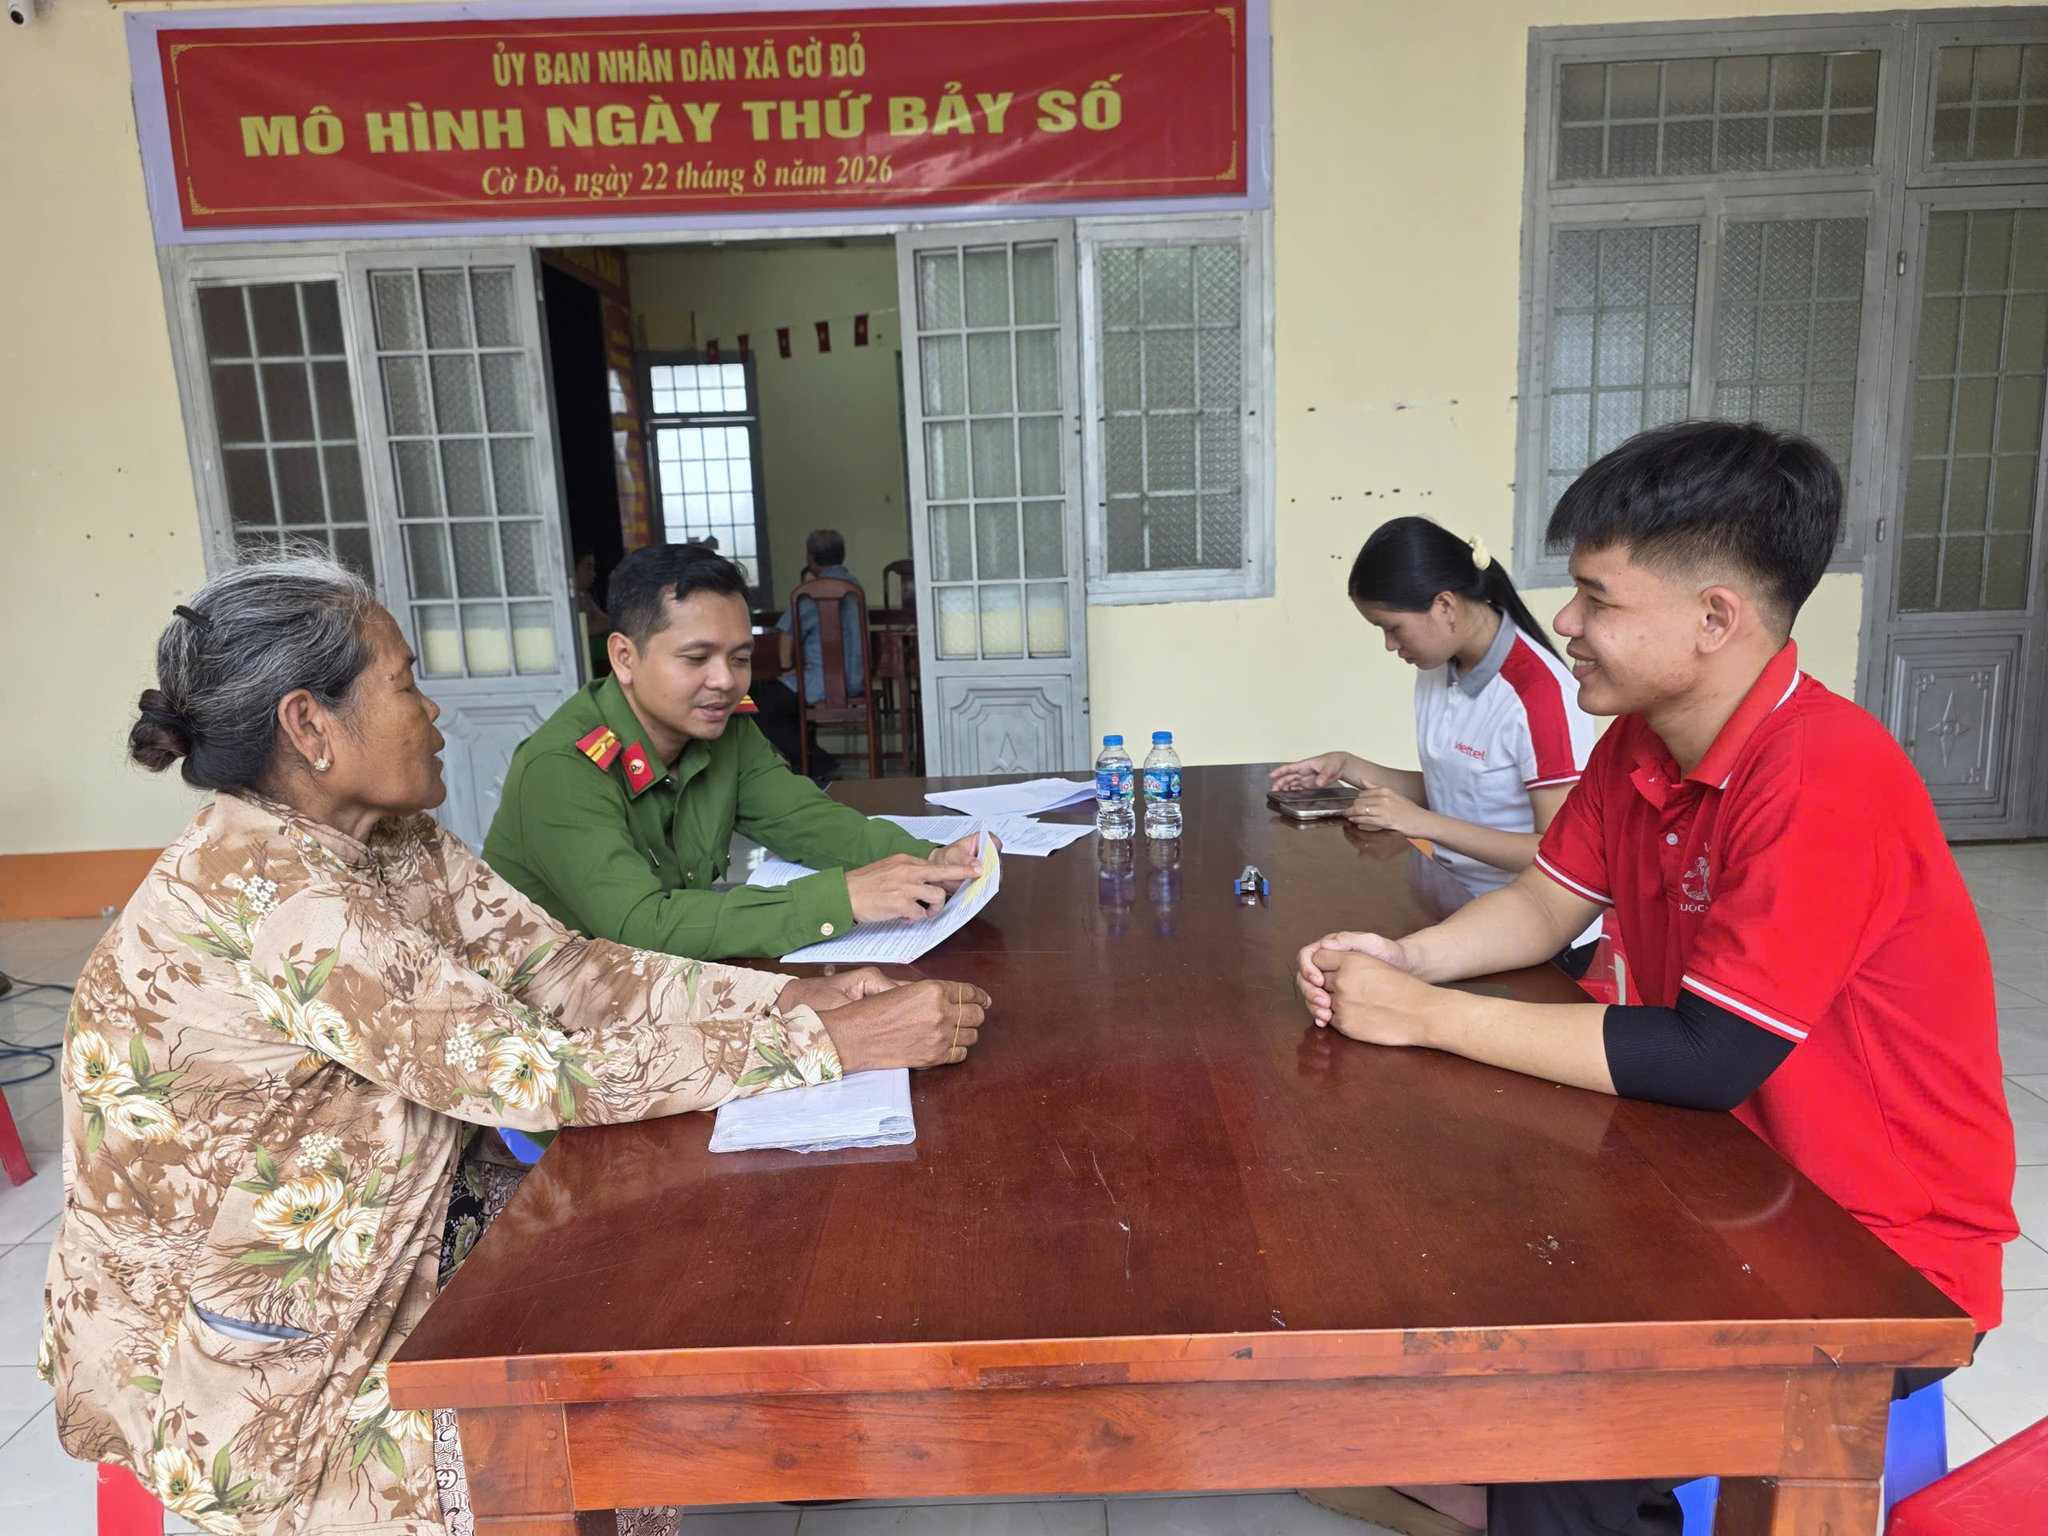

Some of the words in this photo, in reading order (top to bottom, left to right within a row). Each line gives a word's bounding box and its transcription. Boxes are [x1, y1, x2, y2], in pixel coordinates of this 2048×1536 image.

[493, 41, 525, 86] ỦY
[534, 51, 590, 85] BAN
[598, 42, 673, 83] NHÂN
[681, 40, 736, 82] DÂN
[743, 39, 780, 80] XÃ
[787, 36, 822, 78] CỜ
[830, 31, 865, 77] ĐỎ
[240, 105, 345, 157] MÔ
[365, 101, 525, 153] HÌNH
[546, 95, 721, 147] NGÀY
[742, 90, 872, 140] THỨ
[888, 81, 1014, 136] BẢY
[1037, 73, 1124, 133] SỐ
[482, 166, 518, 195] Cờ
[574, 163, 633, 200] ngày
[640, 162, 669, 191] 22
[676, 160, 745, 196] tháng
[753, 158, 767, 187] 8
[774, 158, 827, 186] năm
[835, 153, 893, 185] 2026
